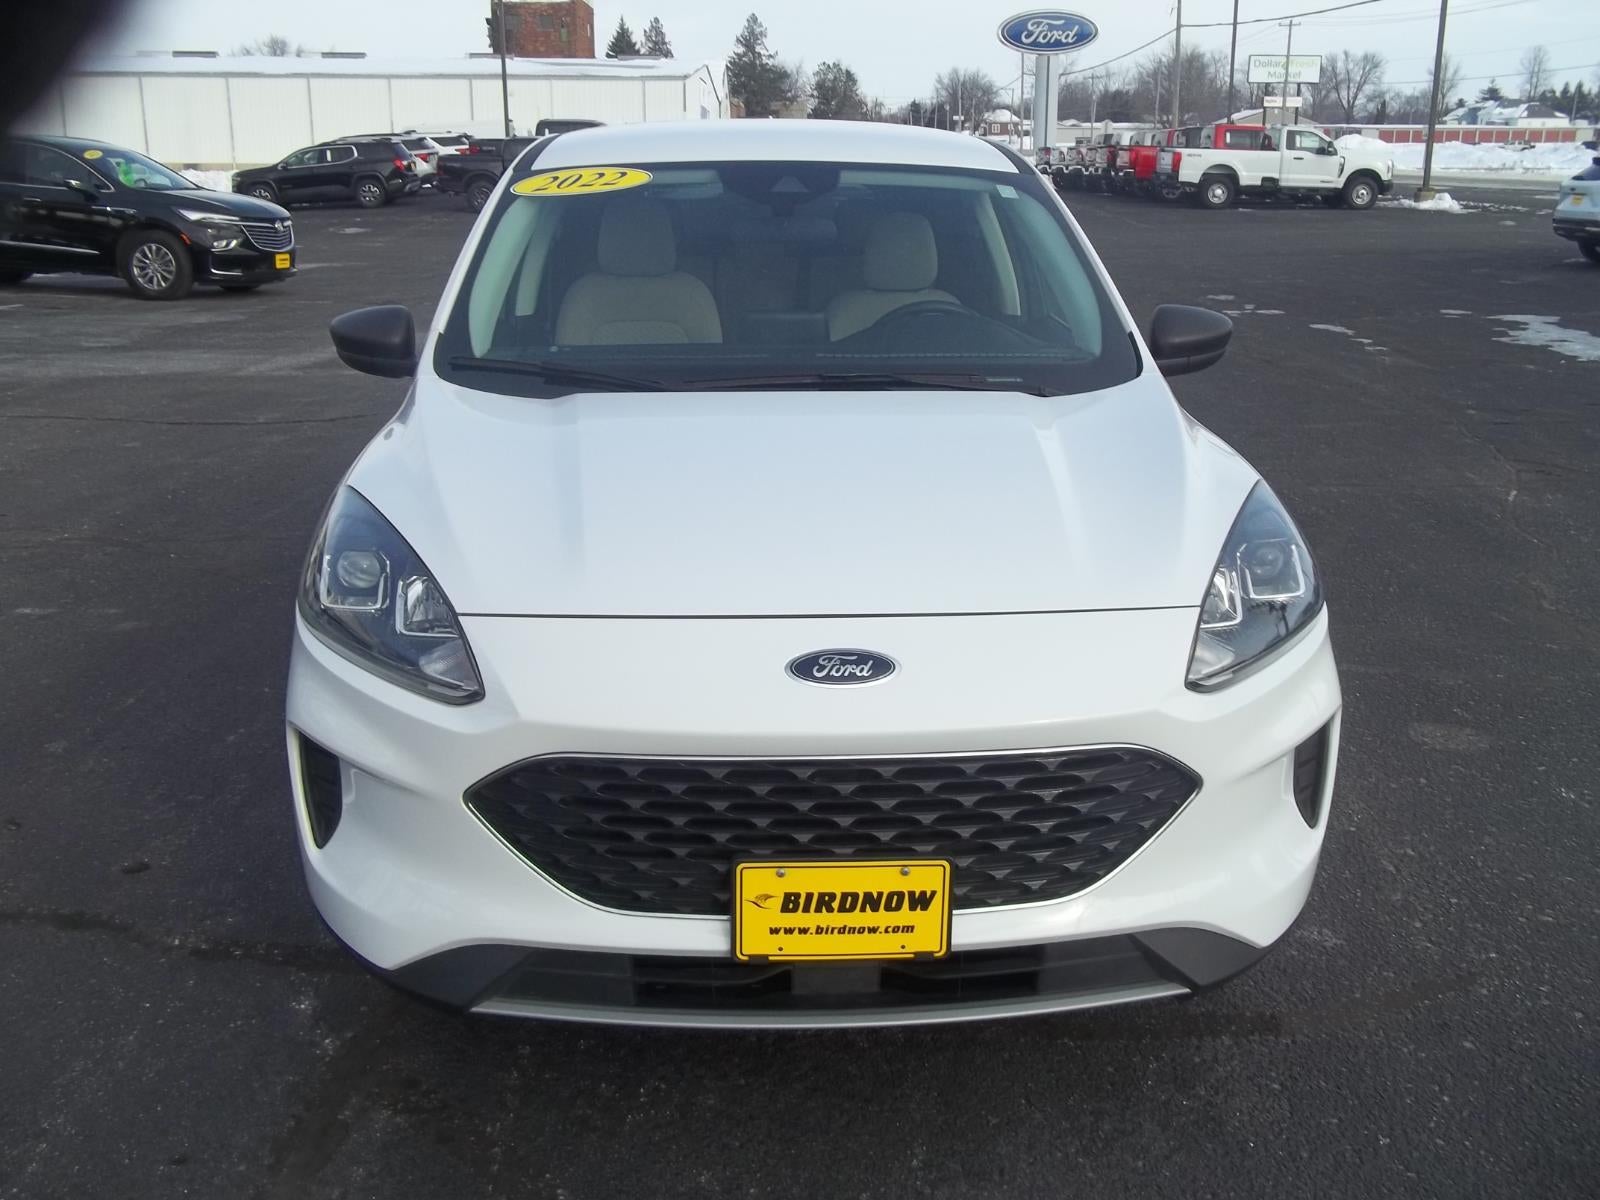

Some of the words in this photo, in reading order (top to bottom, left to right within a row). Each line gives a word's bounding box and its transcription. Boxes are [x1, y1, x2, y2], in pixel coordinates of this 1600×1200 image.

[1021, 18, 1079, 44] Ford
[1253, 59, 1281, 68] Dollar
[531, 171, 628, 193] 2022
[812, 654, 874, 678] Ford
[779, 889, 938, 914] BIRDNOW
[768, 924, 916, 936] www.birdnow.com
